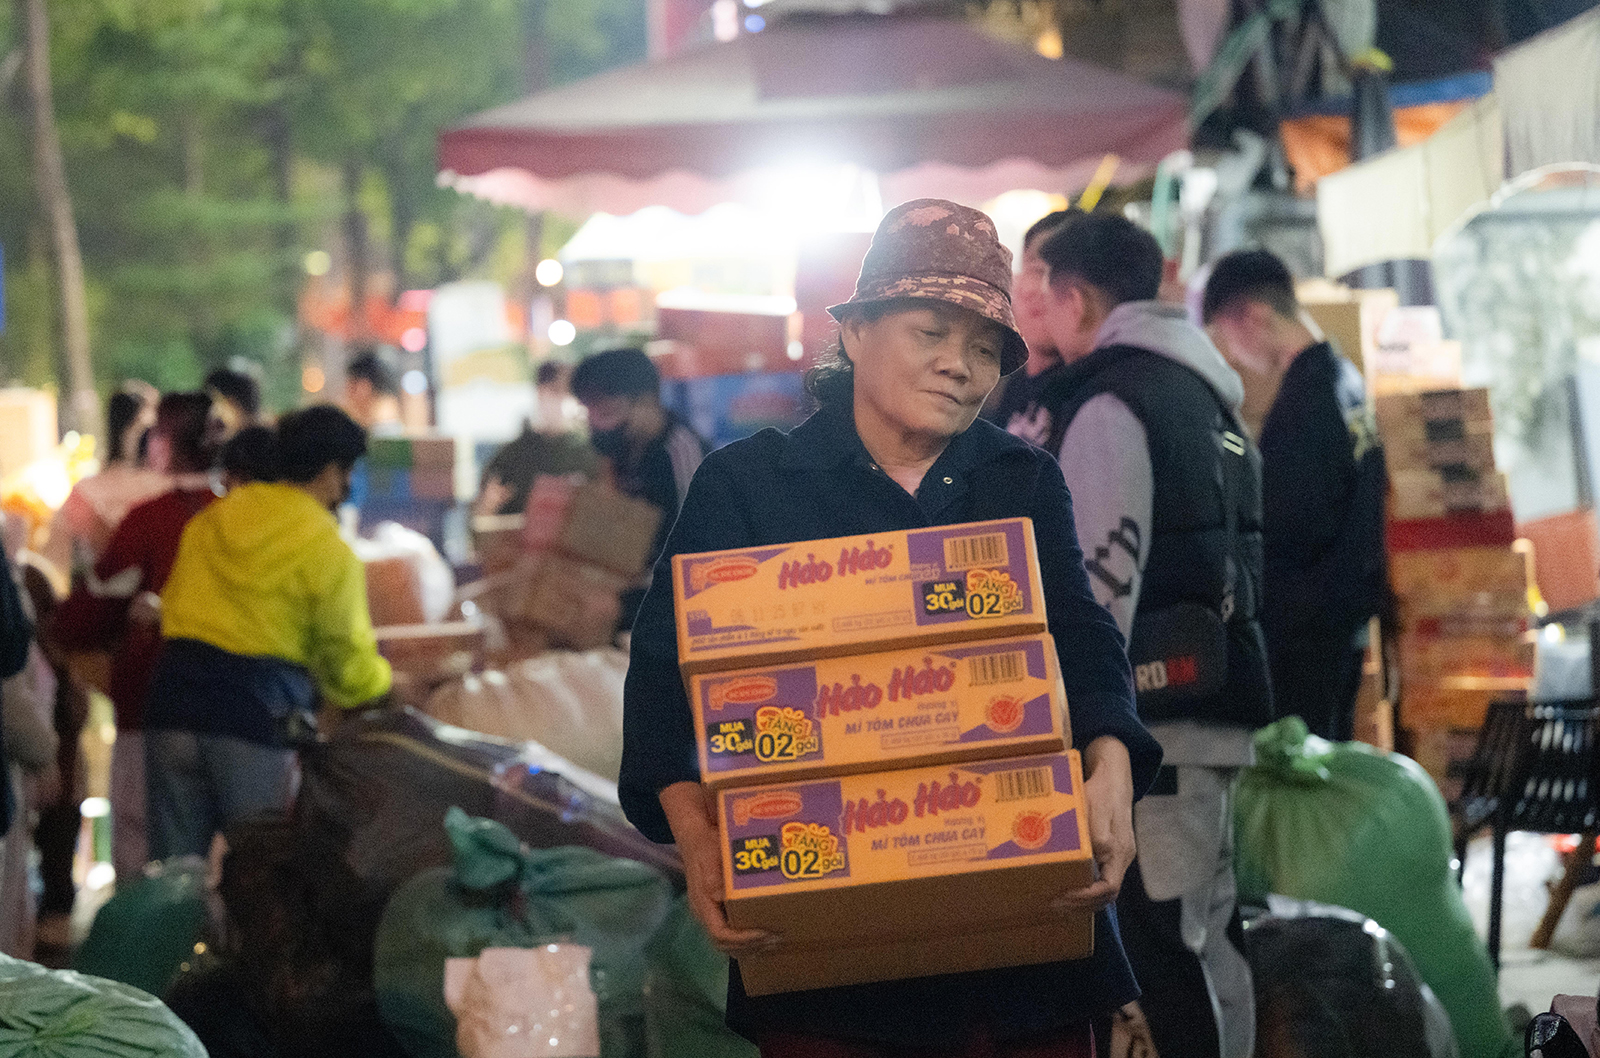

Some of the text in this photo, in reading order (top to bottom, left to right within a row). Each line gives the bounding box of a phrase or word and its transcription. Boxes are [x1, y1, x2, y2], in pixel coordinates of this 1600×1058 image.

[926, 593, 952, 611] 30
[969, 593, 1002, 616] 02
[719, 721, 745, 733] MUA
[710, 733, 741, 753] 30
[759, 733, 794, 758] 02
[745, 838, 771, 850] MUA
[735, 849, 767, 870] 30
[784, 850, 820, 875] 02
